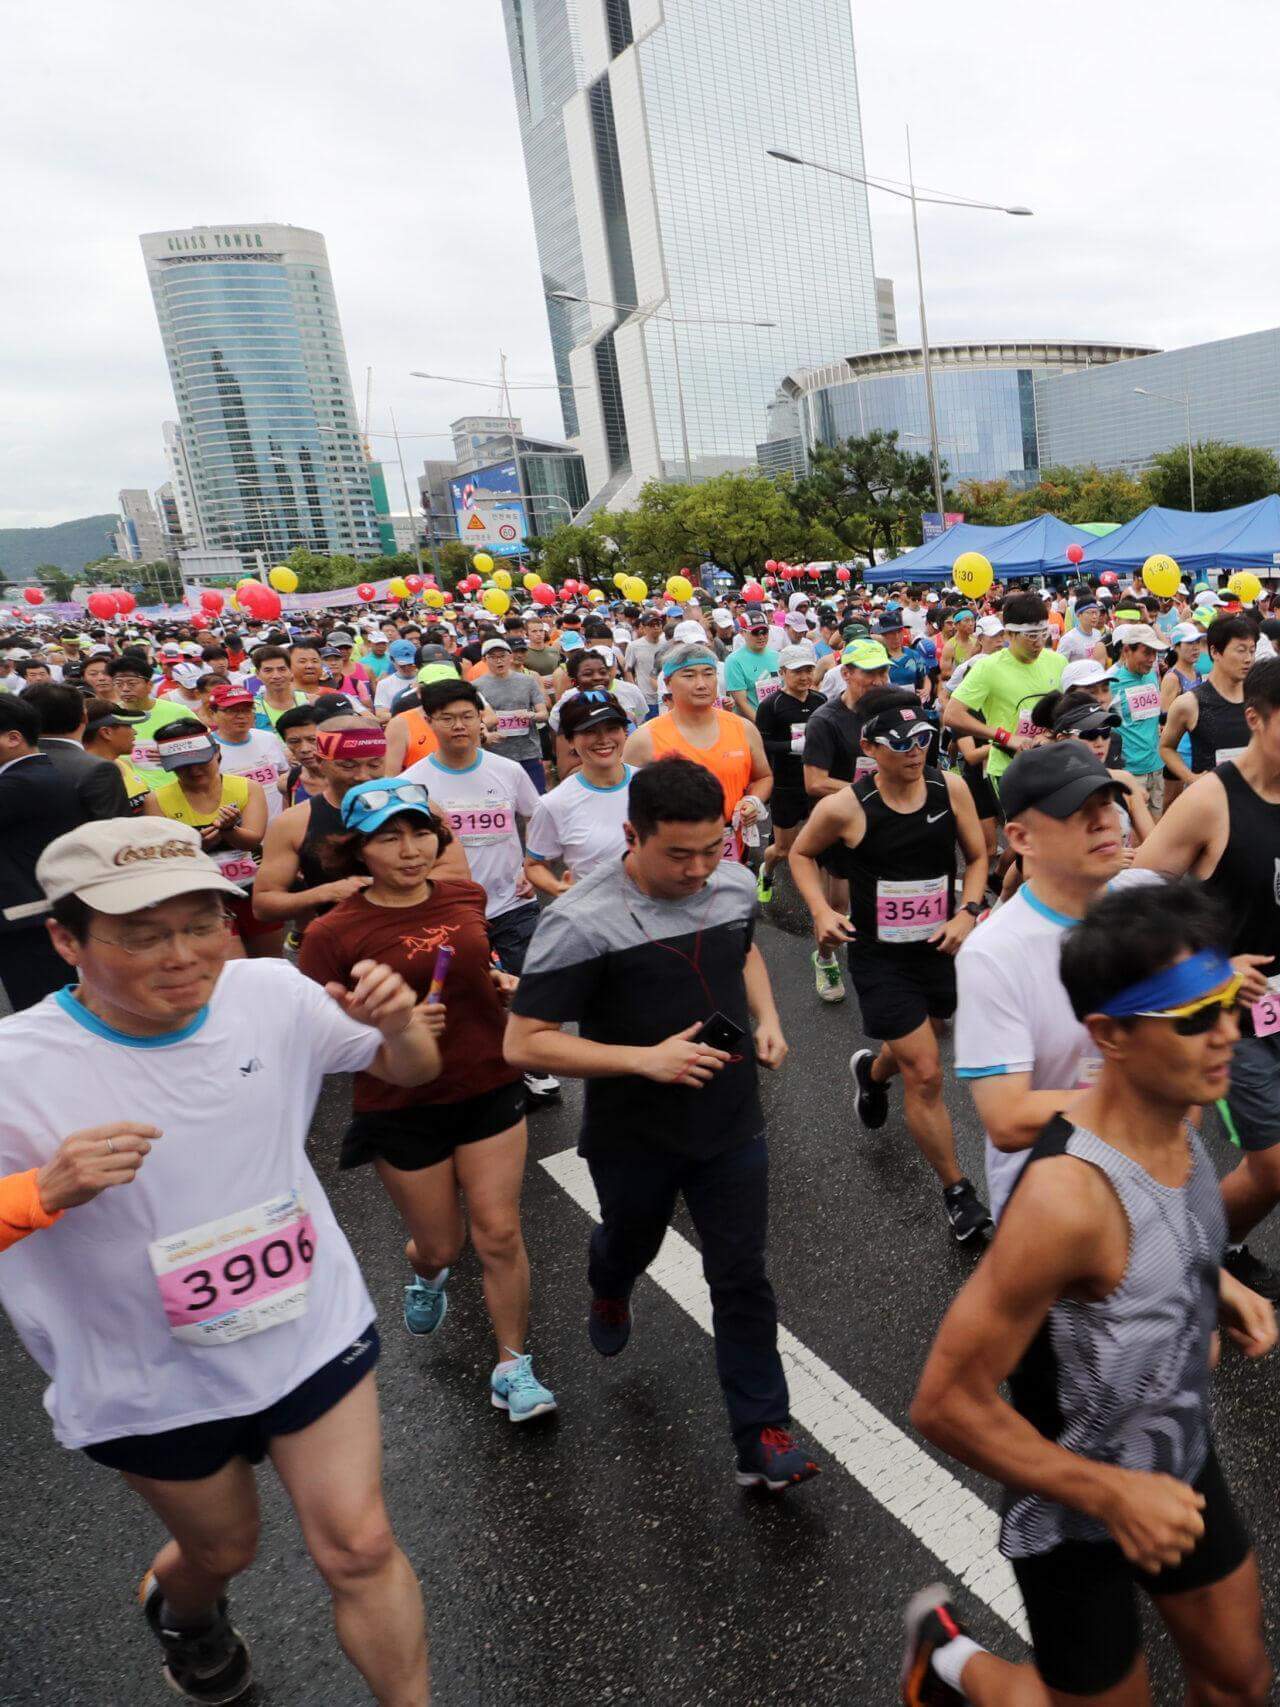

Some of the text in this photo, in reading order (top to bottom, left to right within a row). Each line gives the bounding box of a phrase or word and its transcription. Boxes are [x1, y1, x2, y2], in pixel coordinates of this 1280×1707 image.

[214, 233, 263, 248] TOWER
[450, 813, 506, 830] 3190
[884, 897, 942, 921] 3541
[182, 1227, 314, 1311] 3906
